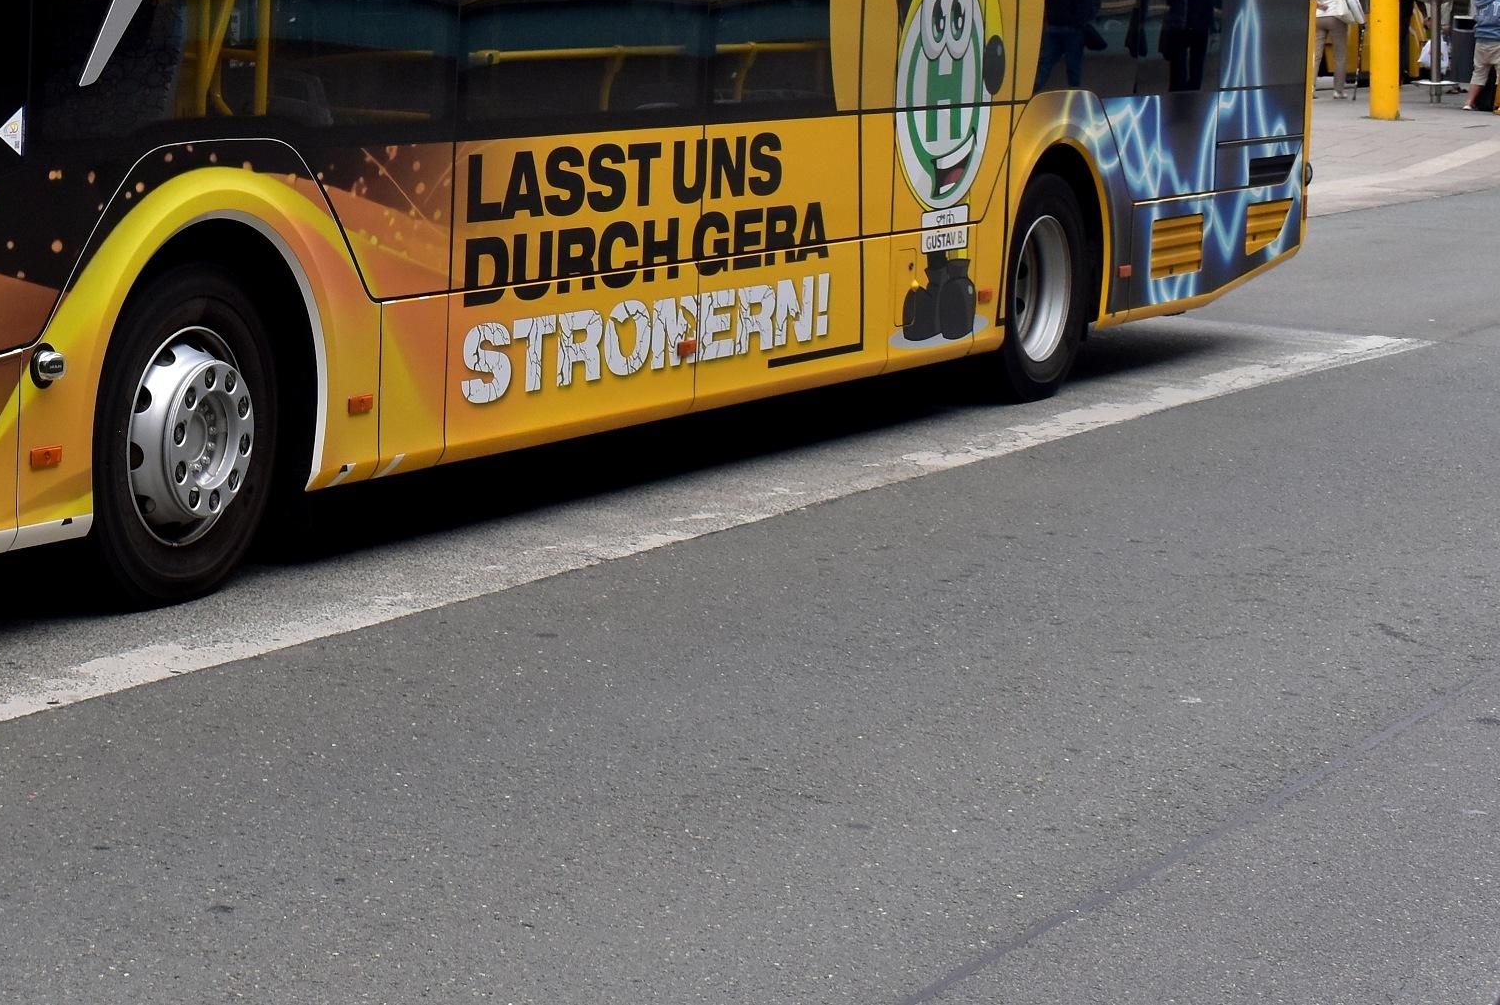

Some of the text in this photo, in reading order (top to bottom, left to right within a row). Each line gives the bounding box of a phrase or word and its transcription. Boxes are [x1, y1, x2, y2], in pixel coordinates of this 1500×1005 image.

[466, 132, 782, 223] LASST UNS
[463, 202, 829, 307] DURCH GERA
[926, 232, 956, 251] GUSTAV
[461, 272, 831, 404] STROMERN!
